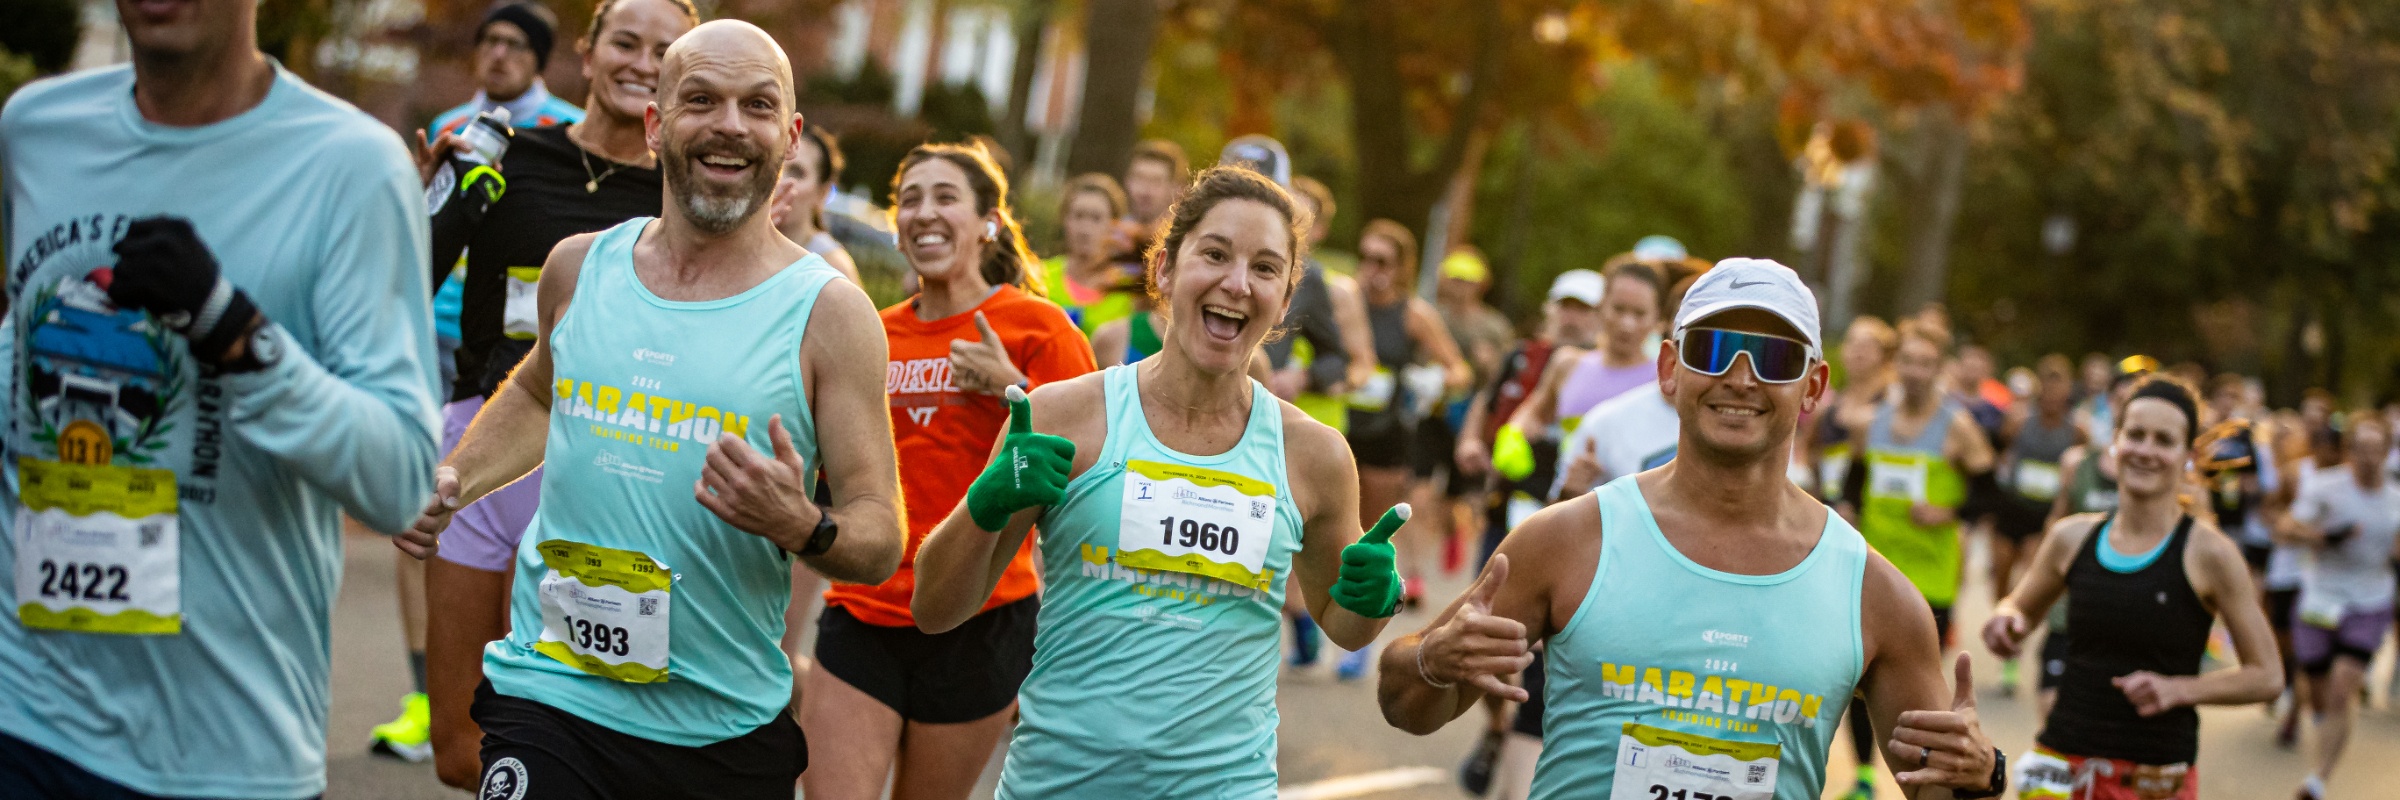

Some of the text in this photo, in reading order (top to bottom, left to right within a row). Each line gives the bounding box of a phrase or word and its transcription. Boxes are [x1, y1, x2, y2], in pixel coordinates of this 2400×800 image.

[631, 374, 661, 391] 2024
[556, 377, 750, 445] MARATHON
[907, 406, 938, 427] VT
[1160, 516, 1239, 555] 1960
[40, 558, 130, 601] 2422
[632, 563, 654, 574] 1393
[564, 615, 630, 657] 1393
[1705, 658, 1737, 672] 2024
[1601, 662, 1824, 729] MARATHON
[1727, 719, 1759, 733] TEAM
